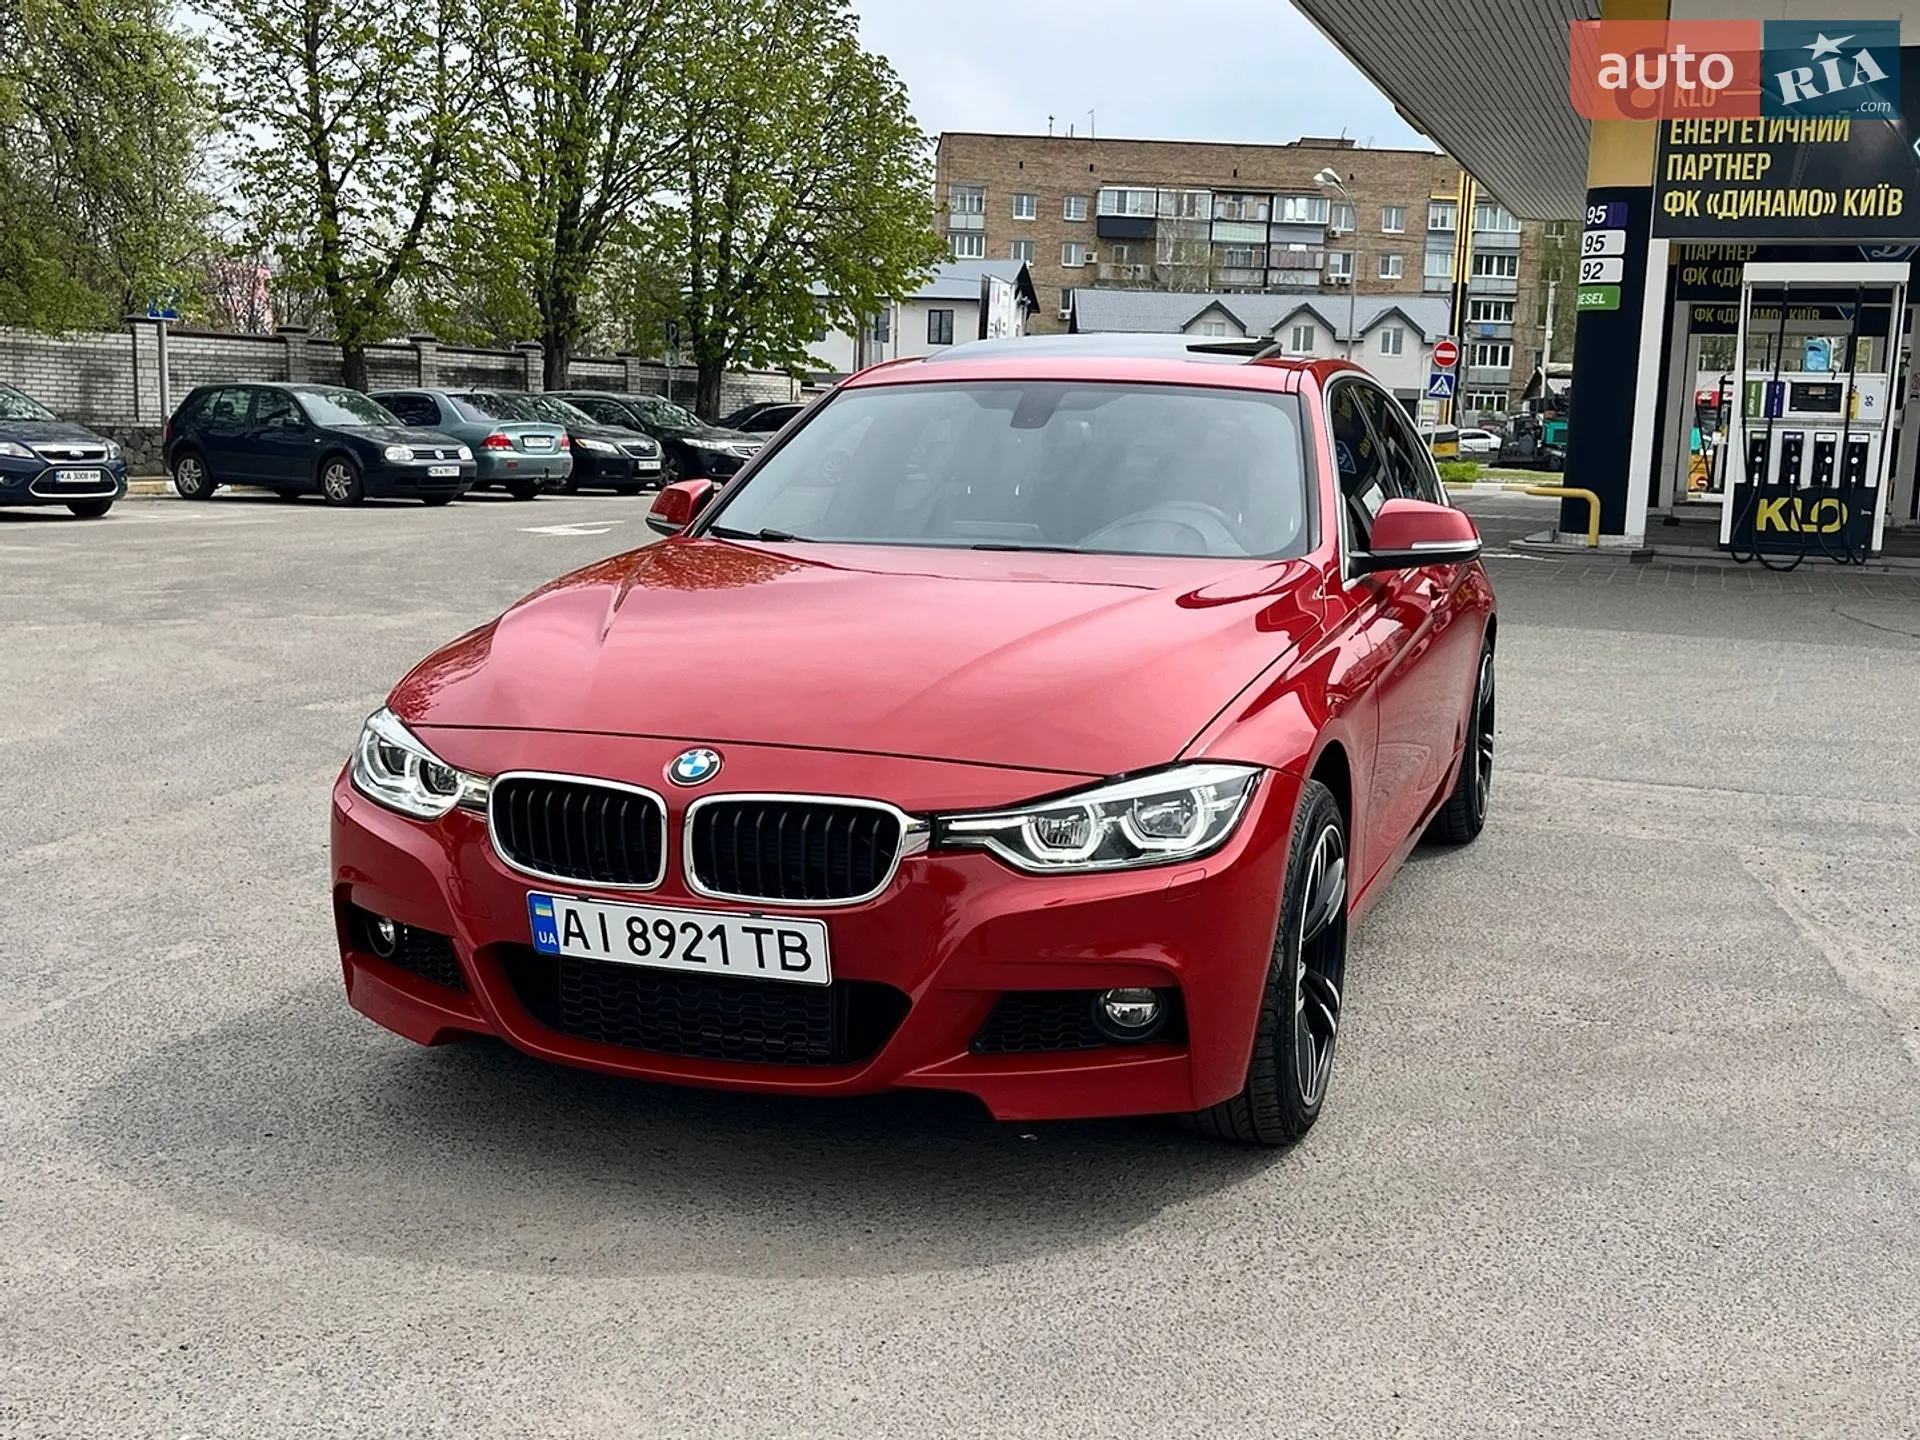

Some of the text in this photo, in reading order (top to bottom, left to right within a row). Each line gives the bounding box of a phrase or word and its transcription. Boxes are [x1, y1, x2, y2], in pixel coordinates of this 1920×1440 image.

[1669, 111, 1850, 144] ЕНЕРГЕТИЧНИЙ
[1666, 153, 1771, 181] ПАРТНЕР
[1663, 184, 1903, 220] ФК «ДИНАМО» КИЇВ
[1586, 205, 1608, 225] 95
[1584, 235, 1606, 254] 95
[1684, 243, 1757, 261] ПАРТНЕР
[1582, 262, 1604, 280] 92
[1682, 267, 1709, 286] ФК
[1694, 307, 1715, 322] ФК
[1756, 497, 1848, 533] KLO
[538, 930, 557, 945] UA
[562, 908, 812, 973] AI 8921 TB
